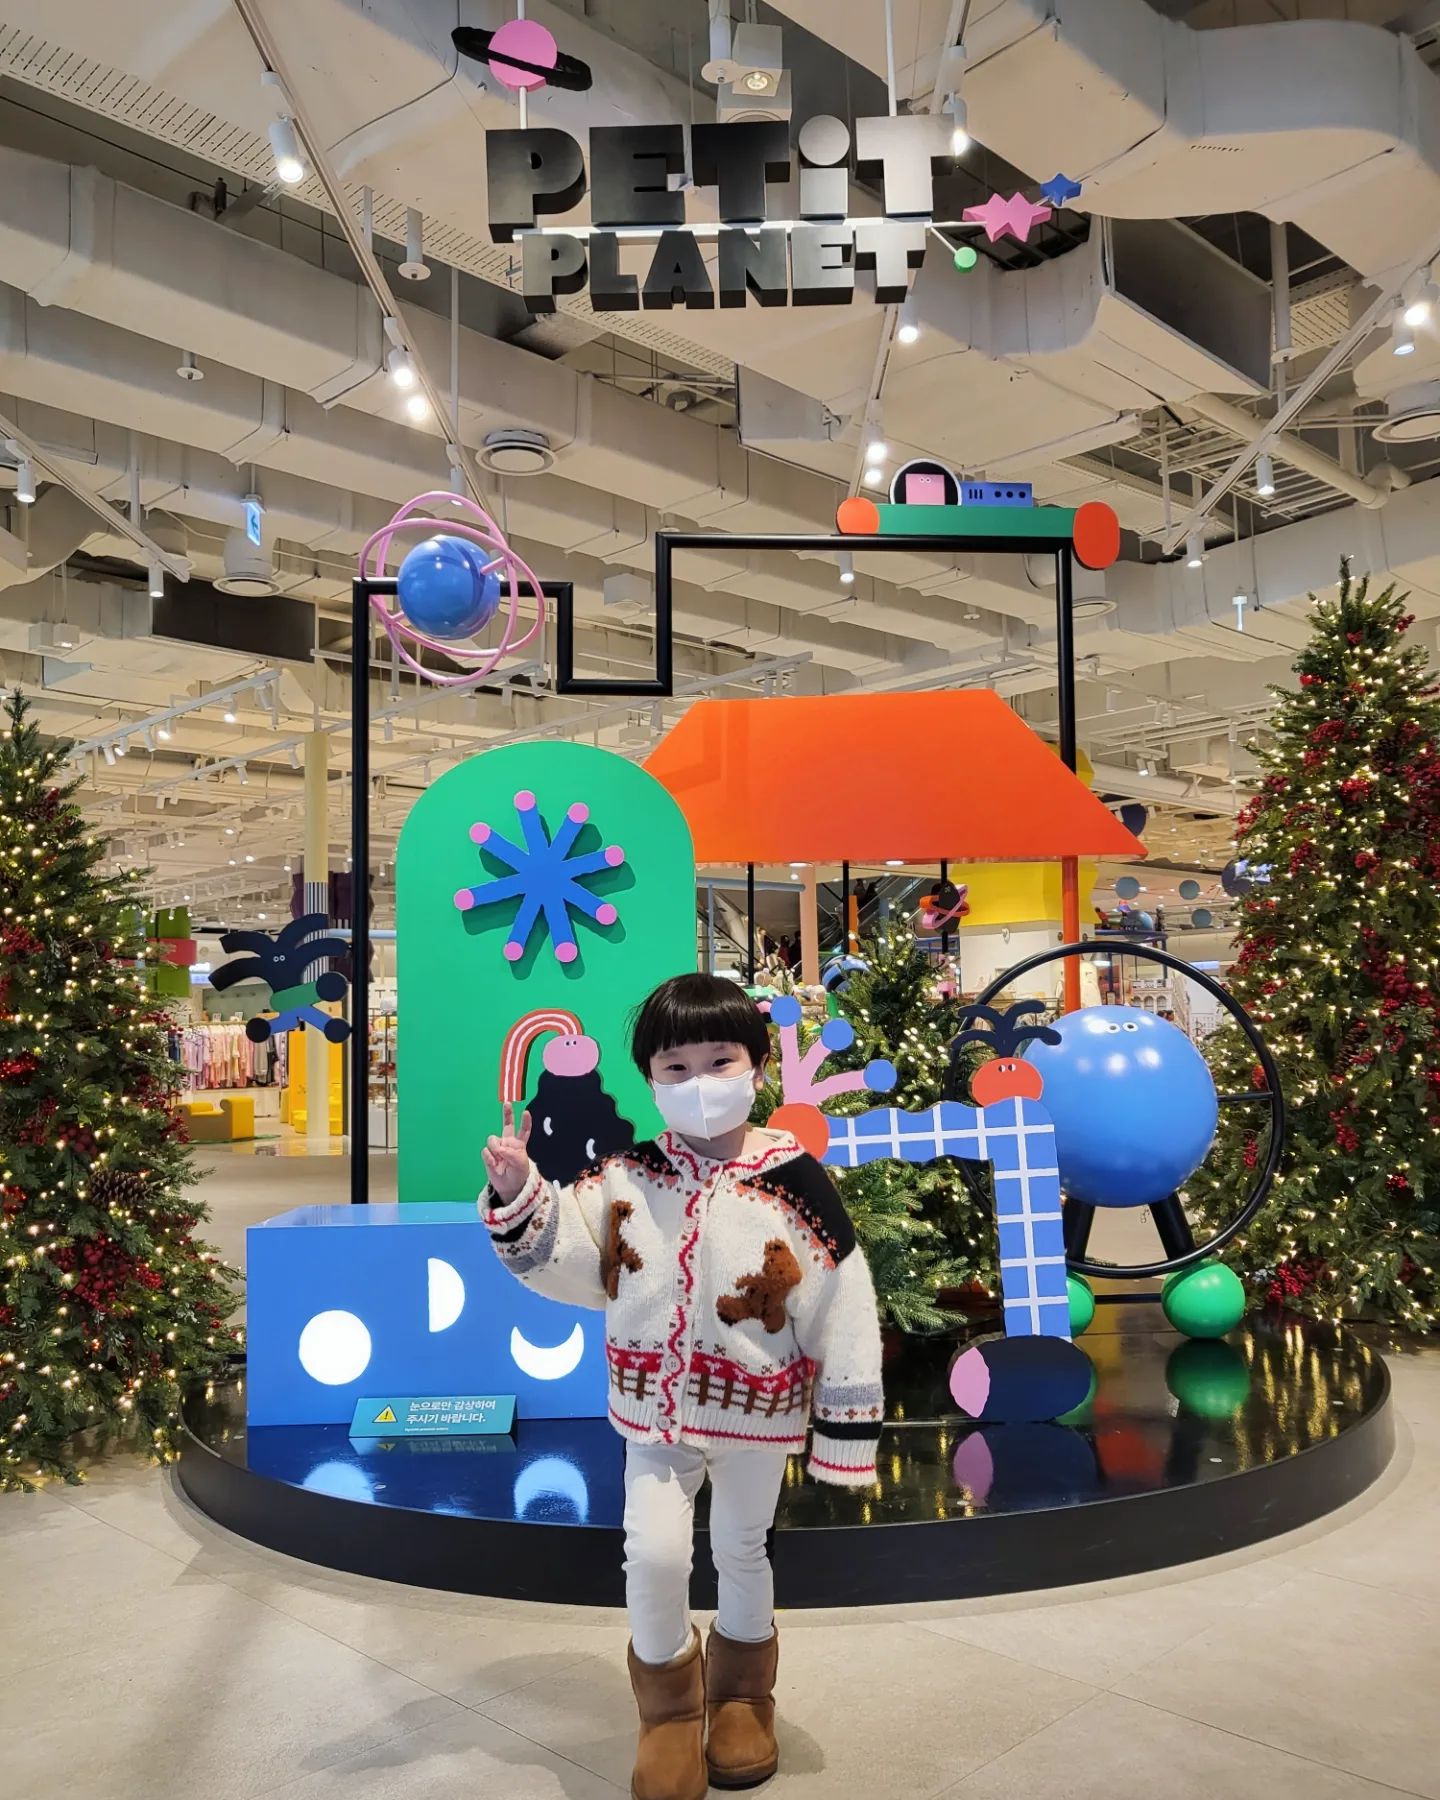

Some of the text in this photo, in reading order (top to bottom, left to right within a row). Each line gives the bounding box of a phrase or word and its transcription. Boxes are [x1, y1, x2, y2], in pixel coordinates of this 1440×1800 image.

[486, 113, 956, 240] PETiT
[521, 223, 927, 313] PLANET
[406, 1412, 487, 1425] 주시기 바랍니다.
[409, 1399, 496, 1412] 눈으로만 감상하여
